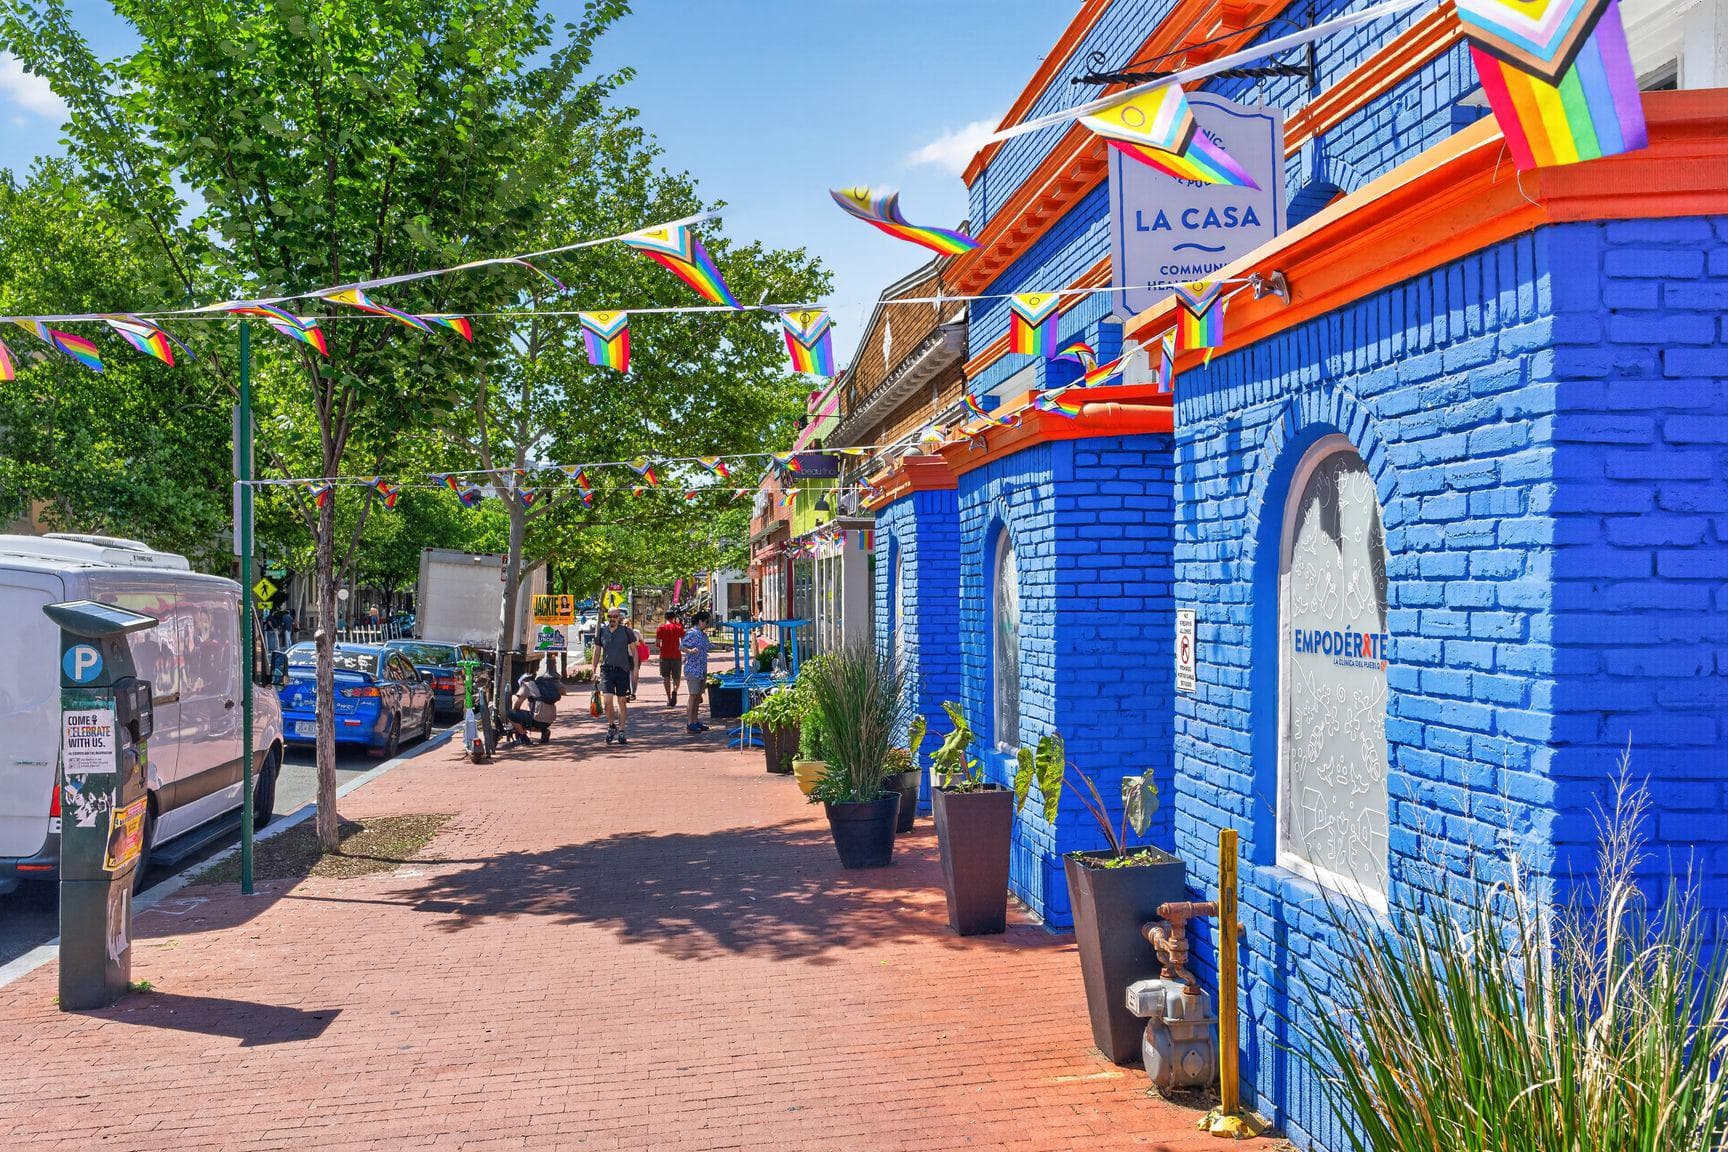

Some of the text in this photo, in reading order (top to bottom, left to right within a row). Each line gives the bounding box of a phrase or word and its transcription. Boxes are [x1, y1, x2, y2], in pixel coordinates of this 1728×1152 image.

[1136, 205, 1261, 231] LA CASA
[534, 596, 558, 616] JACKIE
[75, 647, 98, 680] P
[1364, 661, 1380, 670] PUEBLO
[68, 716, 90, 725] COME
[67, 726, 111, 737] CELEBRATE
[68, 738, 106, 748] WITH US.
